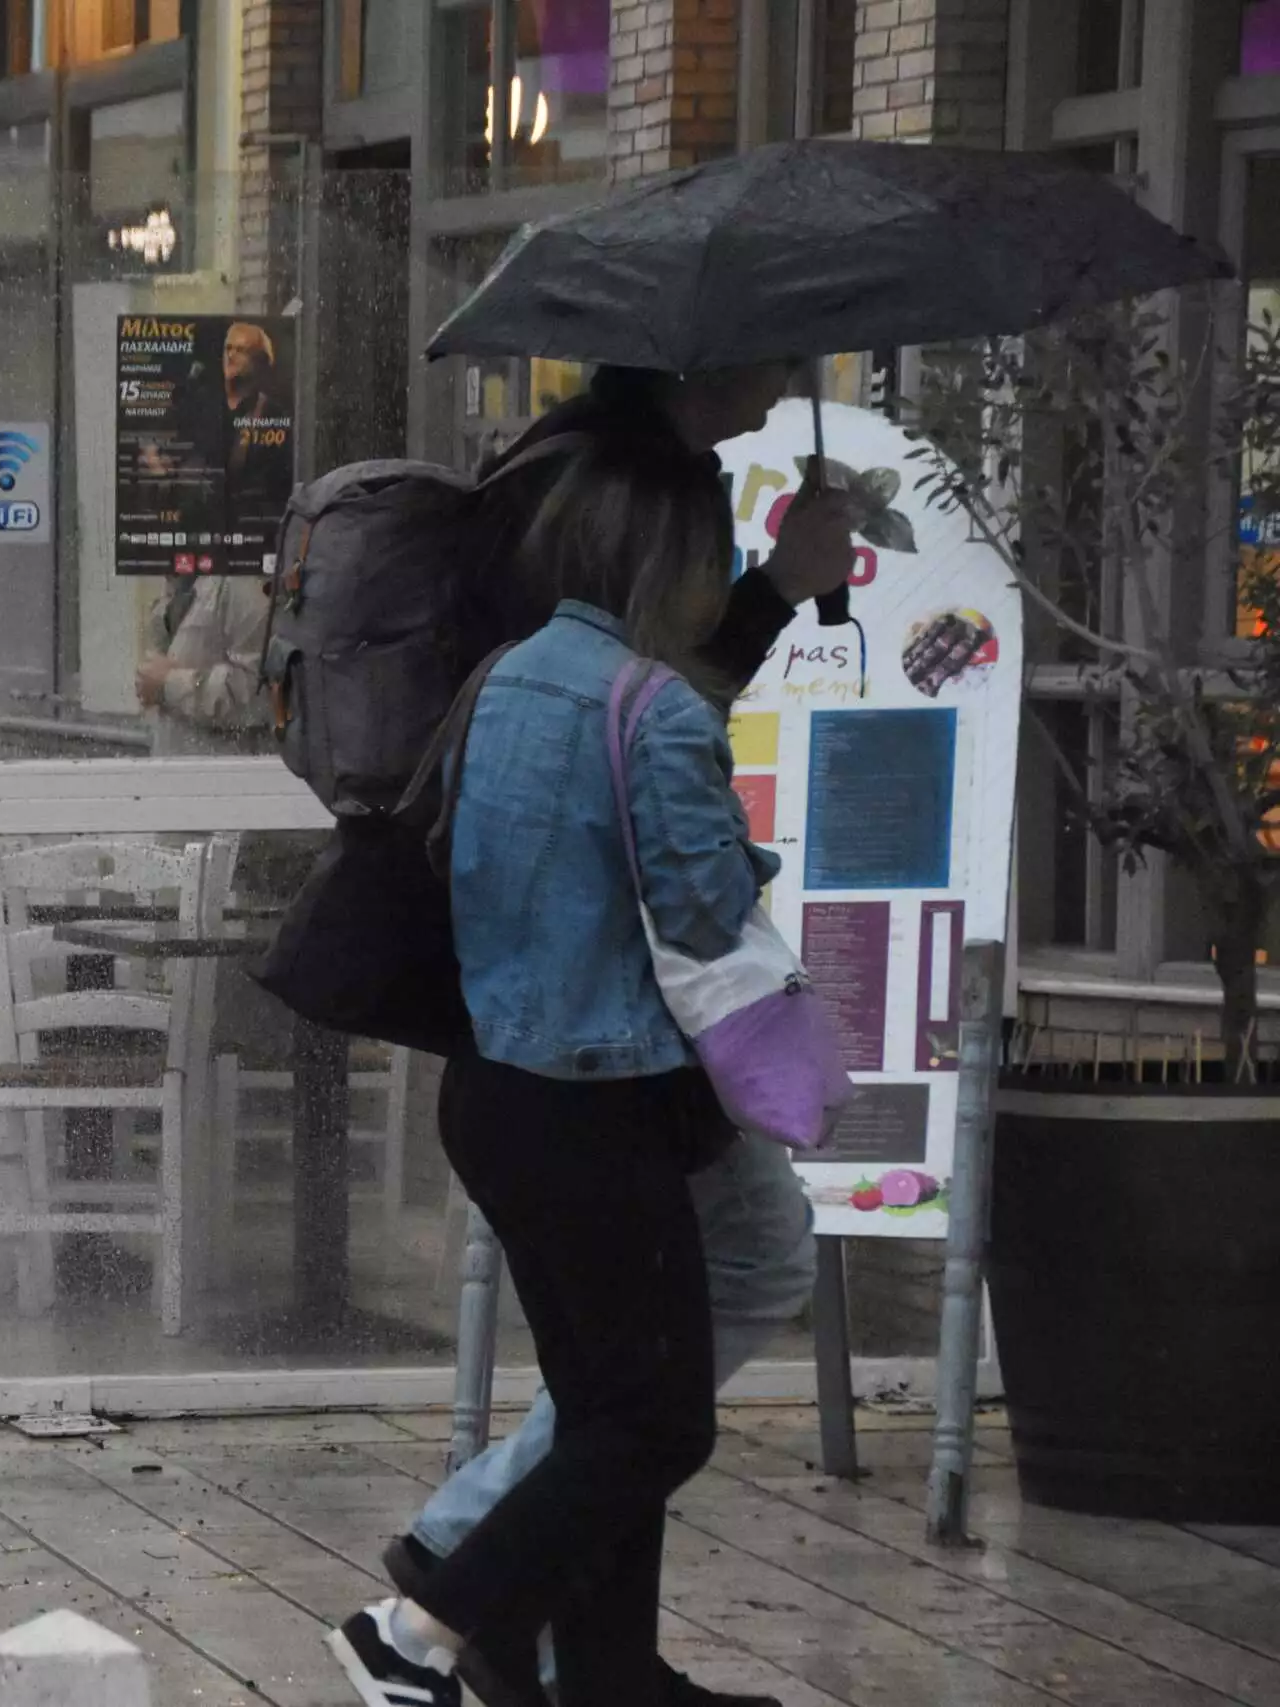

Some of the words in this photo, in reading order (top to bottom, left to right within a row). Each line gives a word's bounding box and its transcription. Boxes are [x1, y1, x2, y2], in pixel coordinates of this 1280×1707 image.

[120, 317, 196, 342] Μίλτος
[120, 341, 194, 353] ΠΑΣΧΑΛΙΔΗΣ
[120, 380, 141, 401] 15
[239, 429, 286, 446] 21:00
[783, 643, 849, 679] μας
